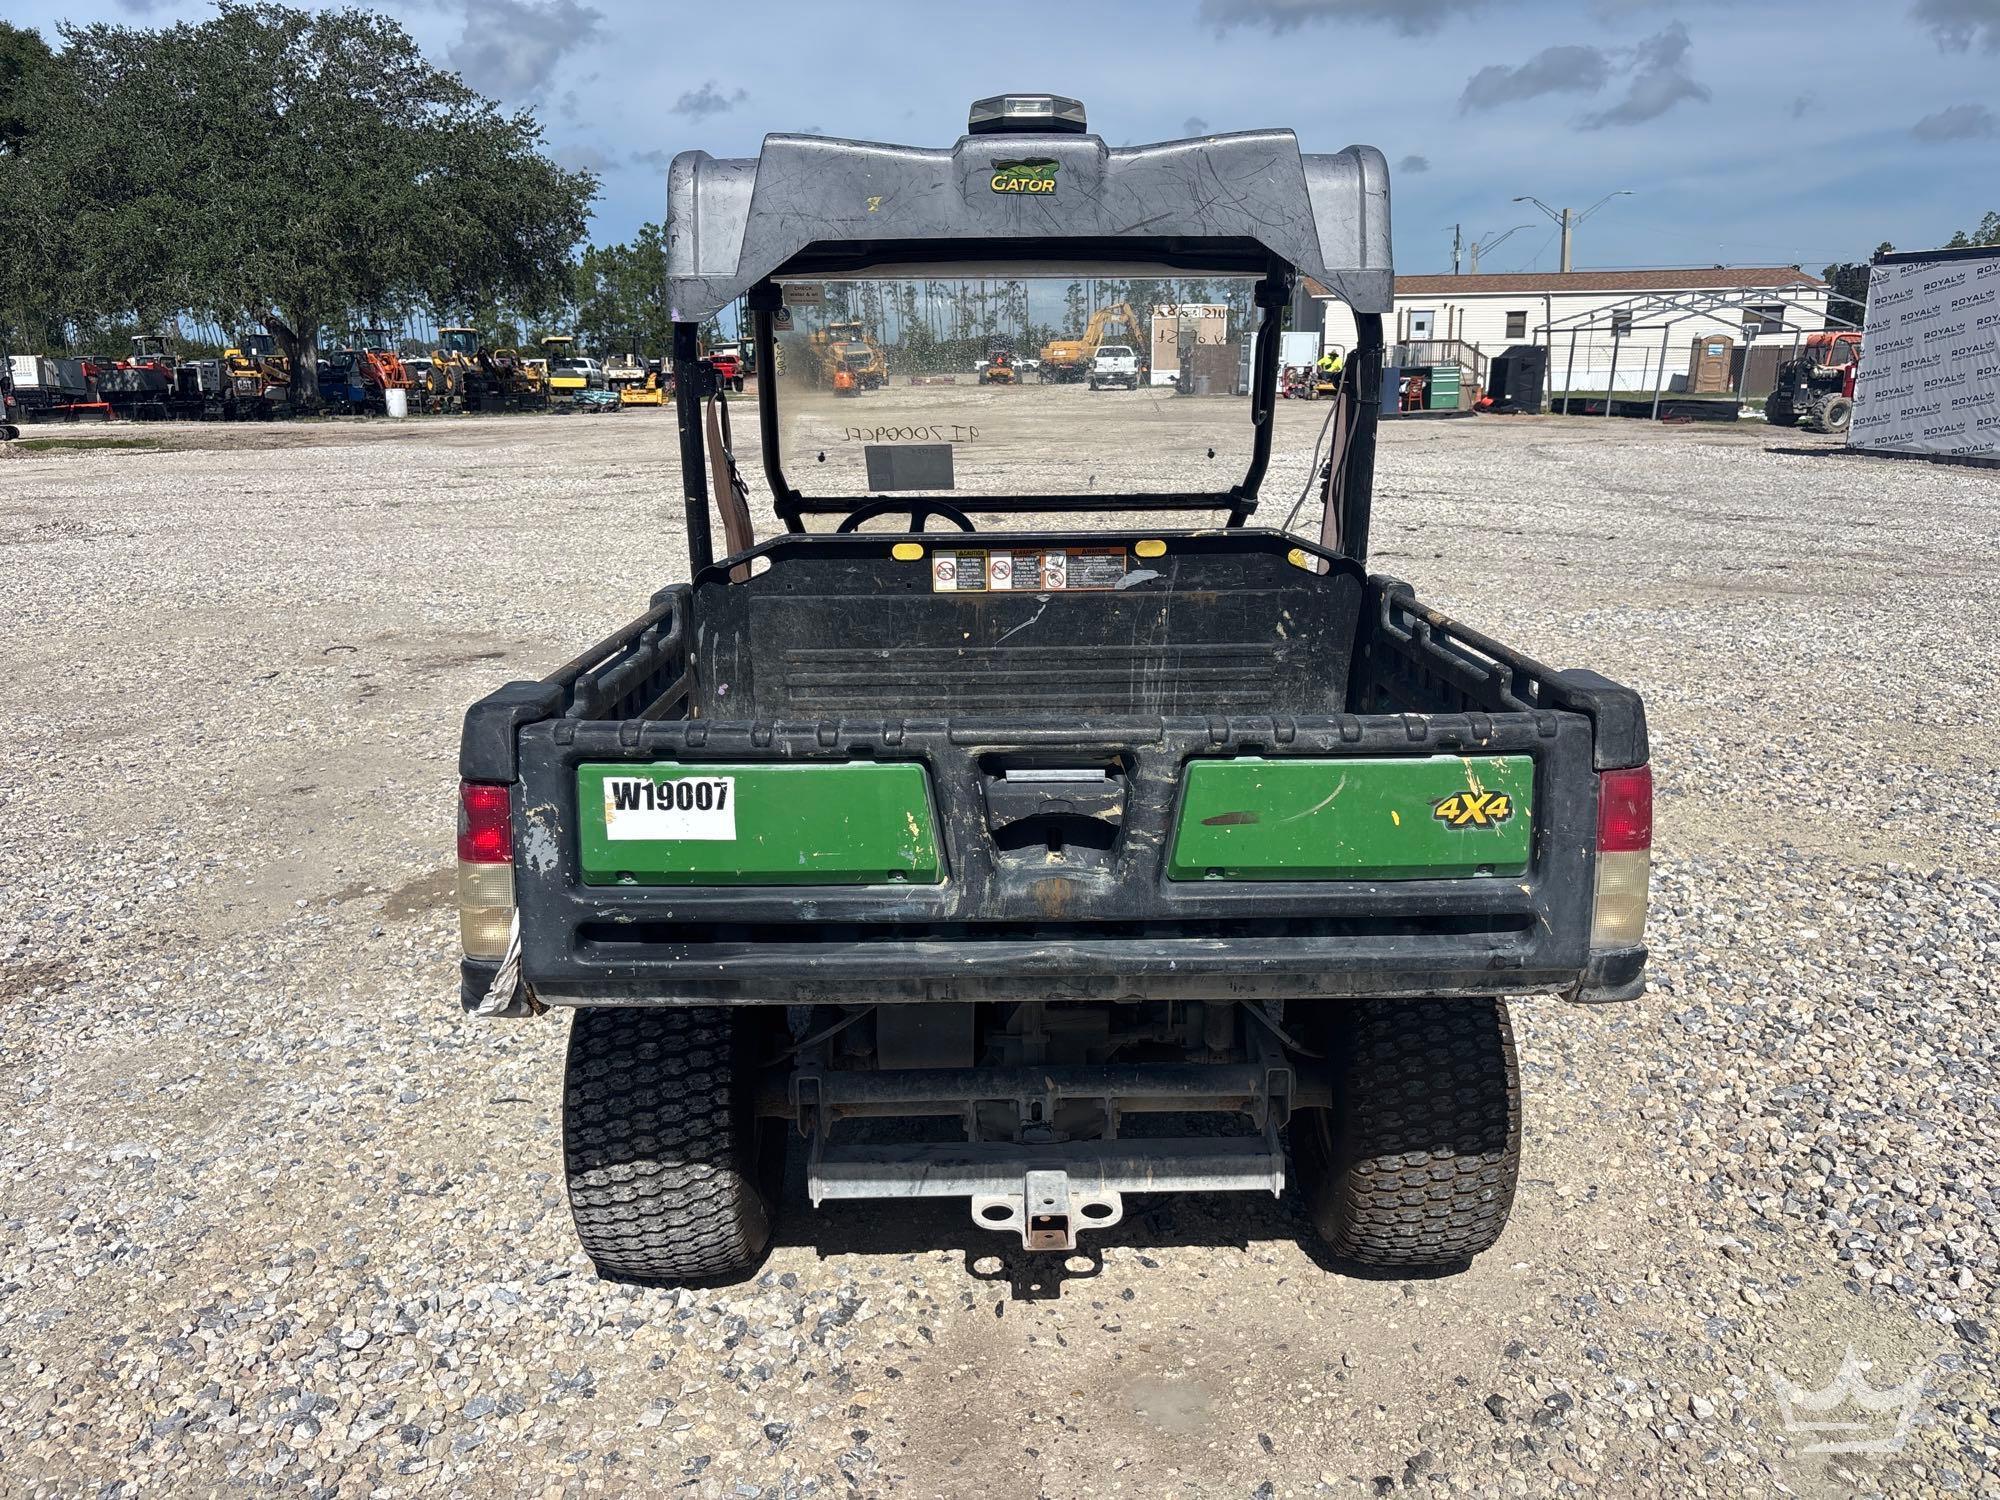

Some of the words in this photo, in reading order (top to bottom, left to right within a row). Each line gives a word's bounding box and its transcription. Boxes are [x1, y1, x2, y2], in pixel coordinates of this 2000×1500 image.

[990, 175, 1056, 192] GATOR
[1923, 276, 1956, 290] ROYAL
[1875, 291, 1905, 305] ROYAL
[1951, 293, 1985, 307] ROYAL
[1901, 308, 1932, 321] ROYAL
[1924, 326, 1956, 339] ROYAL
[1875, 339, 1905, 351] ROYAL
[1951, 344, 1985, 357] ROYAL
[1901, 356, 1932, 369] ROYAL
[237, 379, 252, 391] CAT
[1924, 374, 1956, 388] ROYAL
[1875, 386, 1905, 398] ROYAL
[1951, 394, 1985, 406] ROYAL
[1901, 405, 1932, 417] ROYAL
[1853, 415, 1882, 425] ROYAL
[1923, 424, 1956, 436] ROYAL
[1875, 433, 1905, 445] ROYAL
[1951, 444, 1984, 455] ROYAL
[612, 782, 728, 811] W19007
[1436, 793, 1509, 824] 4X4
